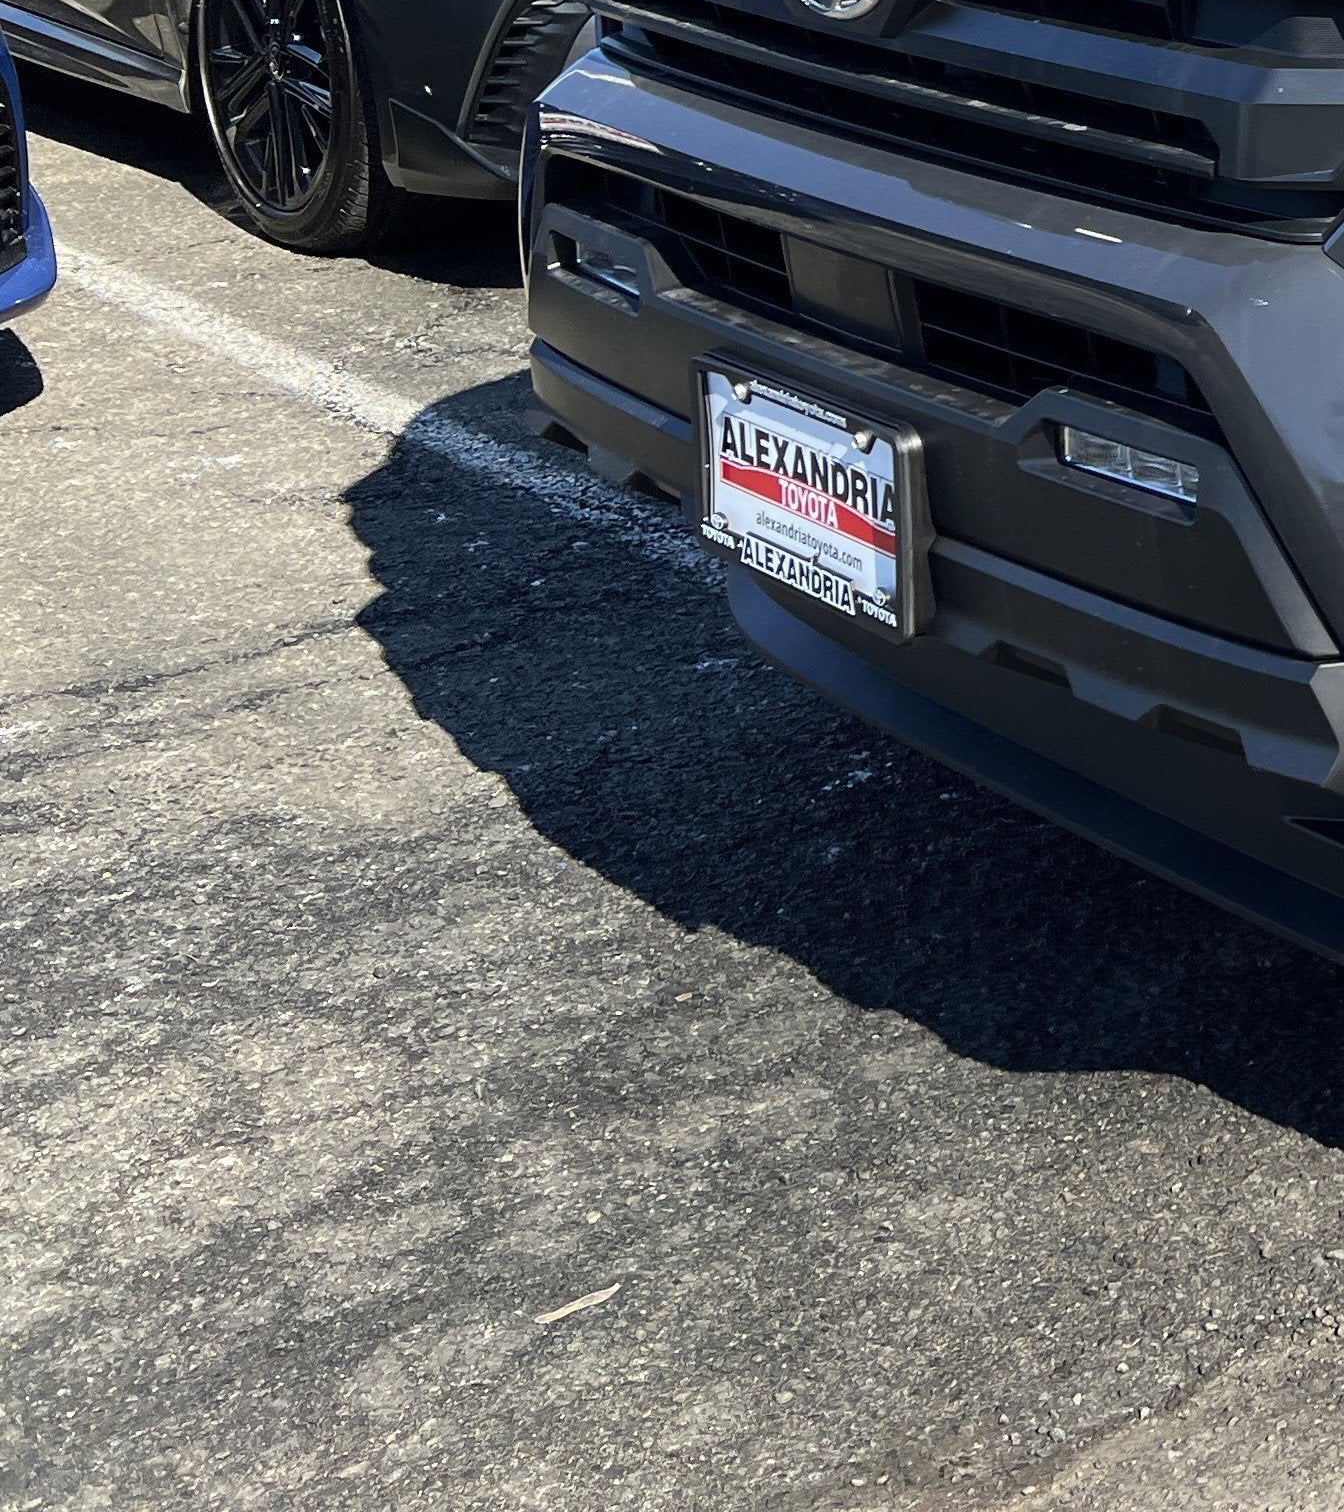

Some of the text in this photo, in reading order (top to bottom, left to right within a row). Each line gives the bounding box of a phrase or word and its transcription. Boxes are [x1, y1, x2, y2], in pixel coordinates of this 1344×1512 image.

[721, 416, 896, 524] ALEXANDRIA
[779, 480, 840, 530] TOYOTA
[700, 523, 735, 549] TOYOTA
[756, 510, 863, 572] alexandriatoyota.com
[742, 538, 854, 615] ALEXANDRIA
[862, 598, 897, 627] TOYOTA
